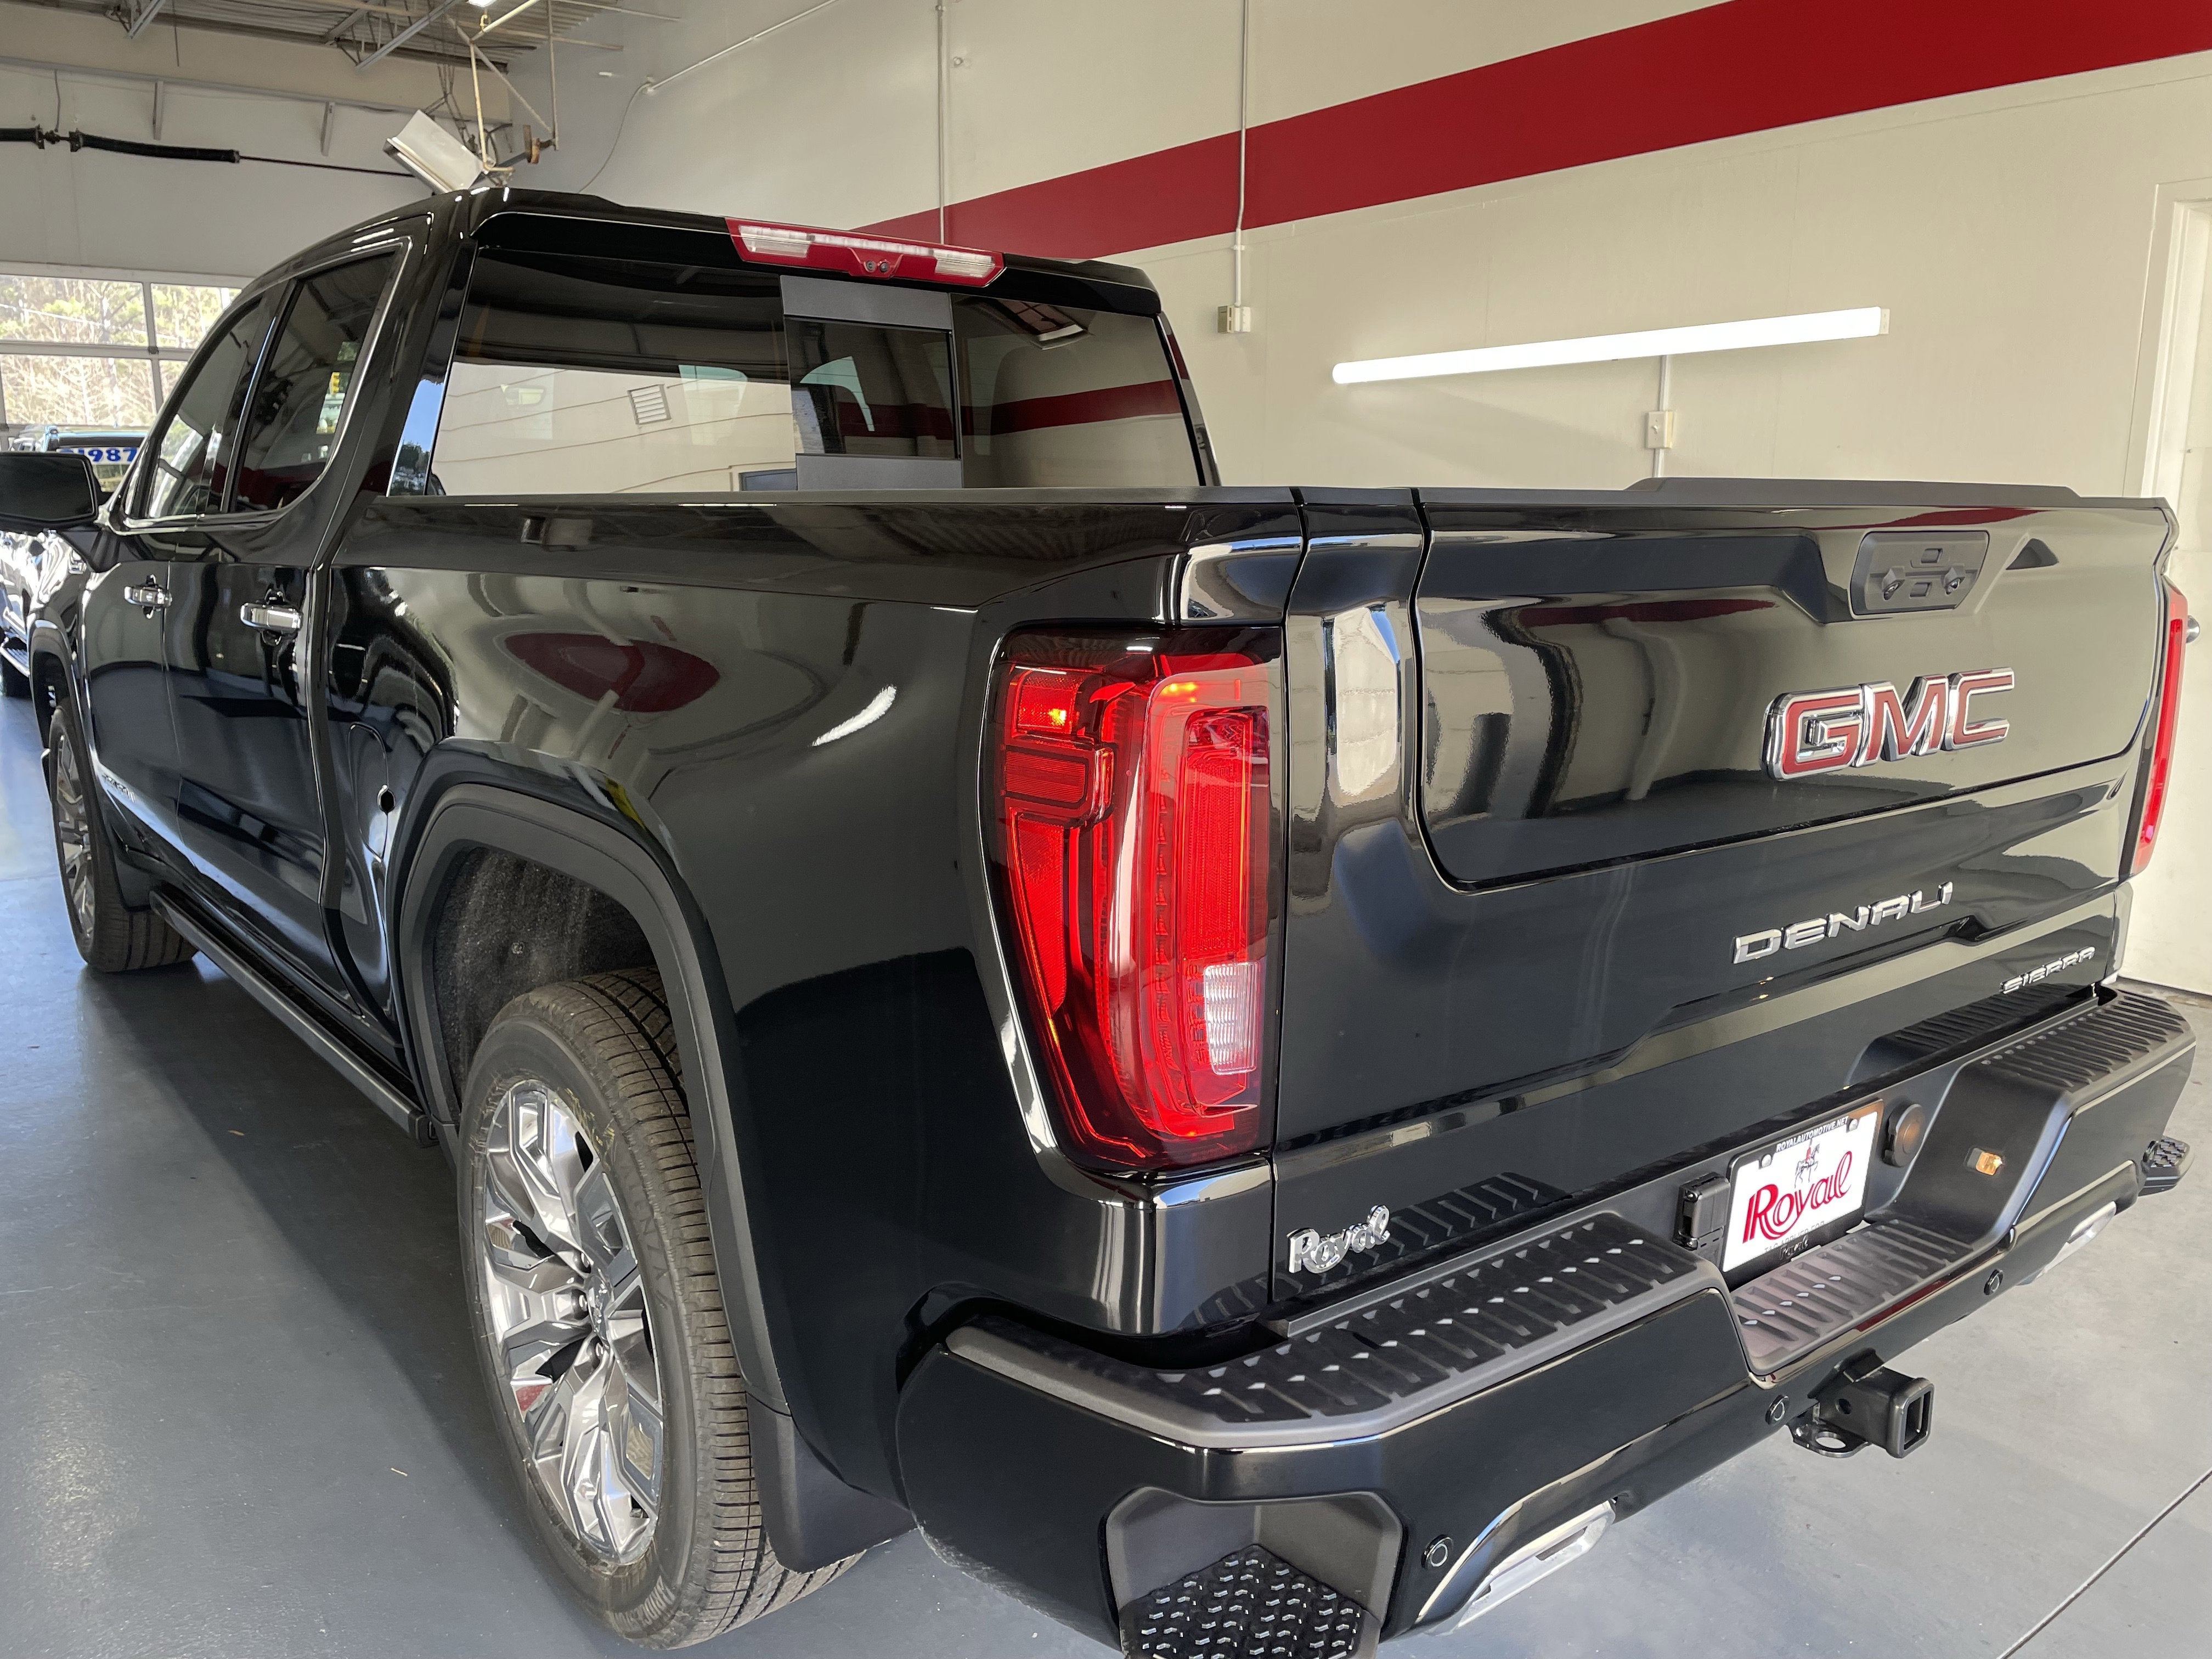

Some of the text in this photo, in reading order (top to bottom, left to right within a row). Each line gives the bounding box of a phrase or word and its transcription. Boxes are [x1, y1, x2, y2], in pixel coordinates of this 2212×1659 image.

[1759, 667, 2015, 782] GMC
[1731, 881, 1953, 964] DENALI
[2000, 946, 2095, 995] SIERRA
[1776, 1116, 1849, 1153] ROYALAUTOMOTIVE.NET
[1742, 1150, 1853, 1244] Royal
[1286, 1204, 1390, 1274] Royal
